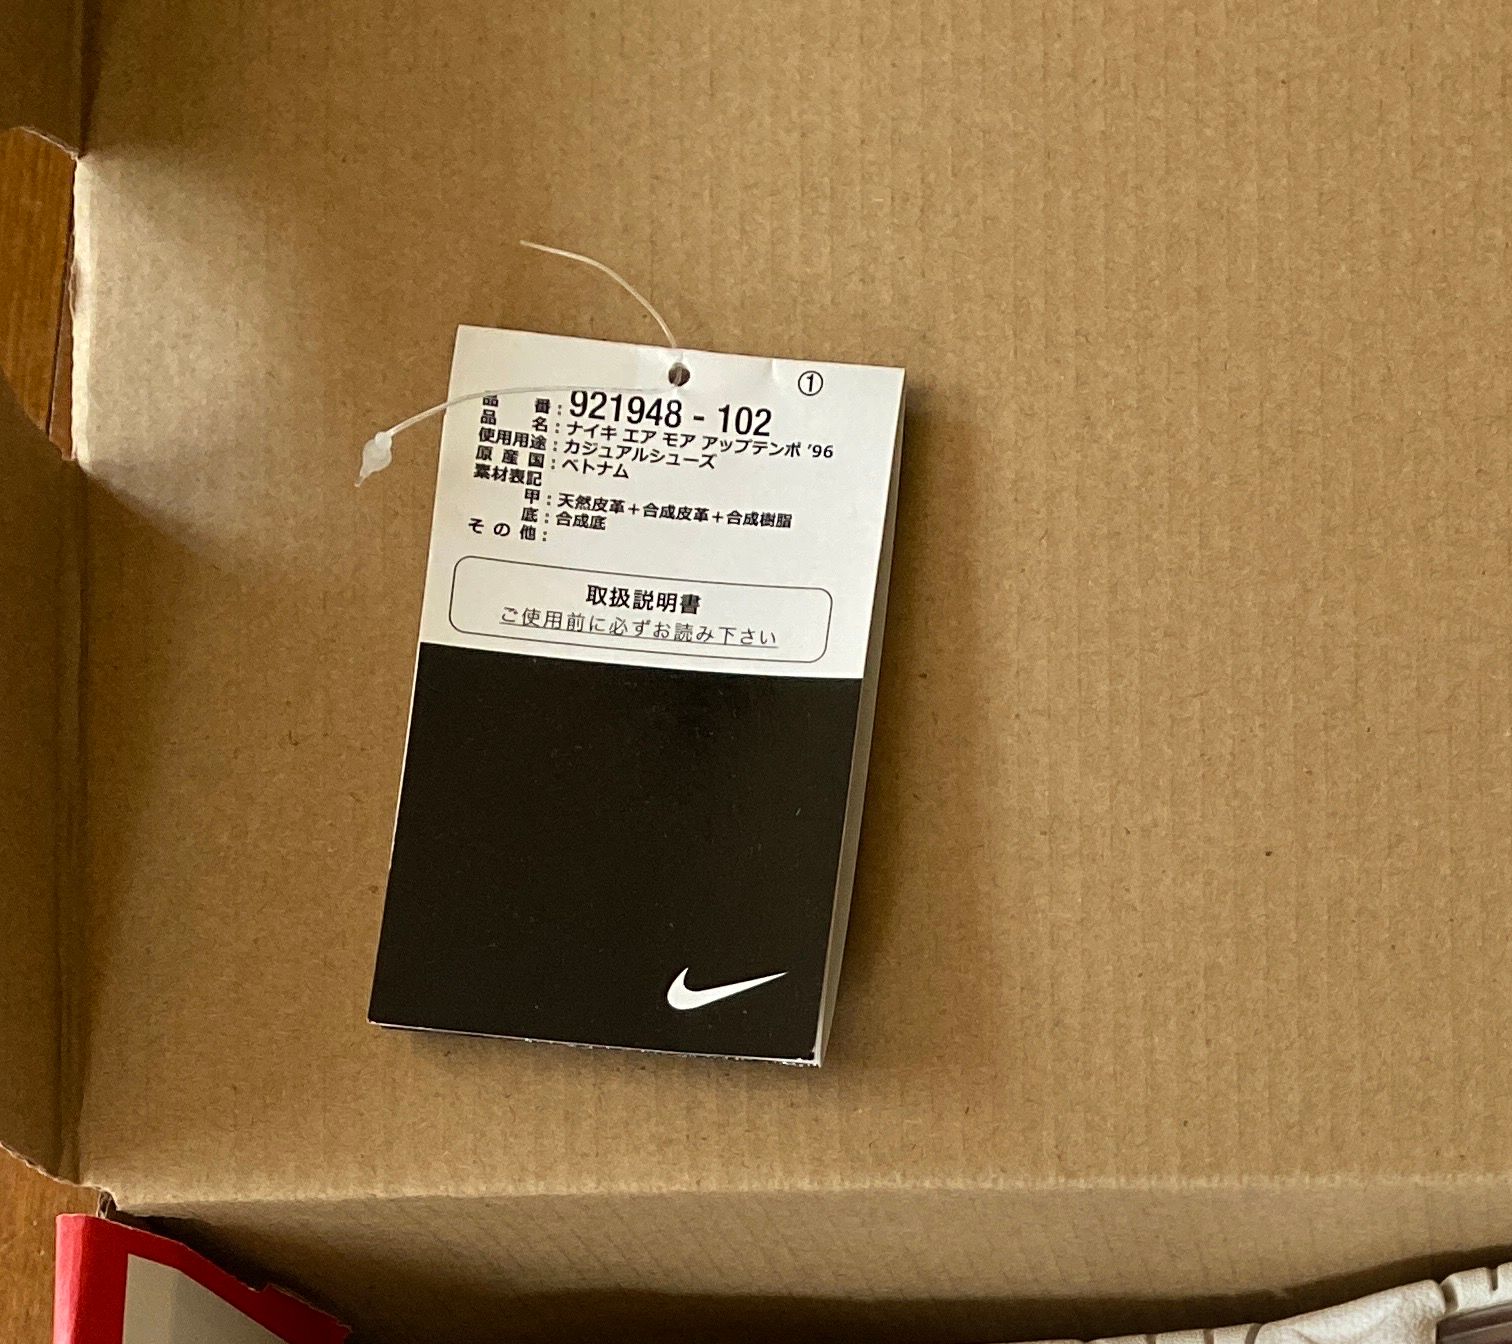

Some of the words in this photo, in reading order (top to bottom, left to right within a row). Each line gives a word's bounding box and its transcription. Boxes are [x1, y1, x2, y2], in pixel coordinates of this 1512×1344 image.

[569, 390, 682, 428] 921948
[718, 404, 773, 437] 102
[566, 421, 617, 441] ナイキ
[622, 427, 657, 445] エア
[662, 432, 696, 448] モア
[561, 458, 630, 480] ベトナム
[563, 439, 717, 470] カジュアルシューズ
[473, 463, 543, 487] 素材表記
[555, 510, 608, 531] 合成底
[586, 584, 701, 616] 取扱説明書
[500, 606, 777, 647] ご使用前に必ずお読み下さい
